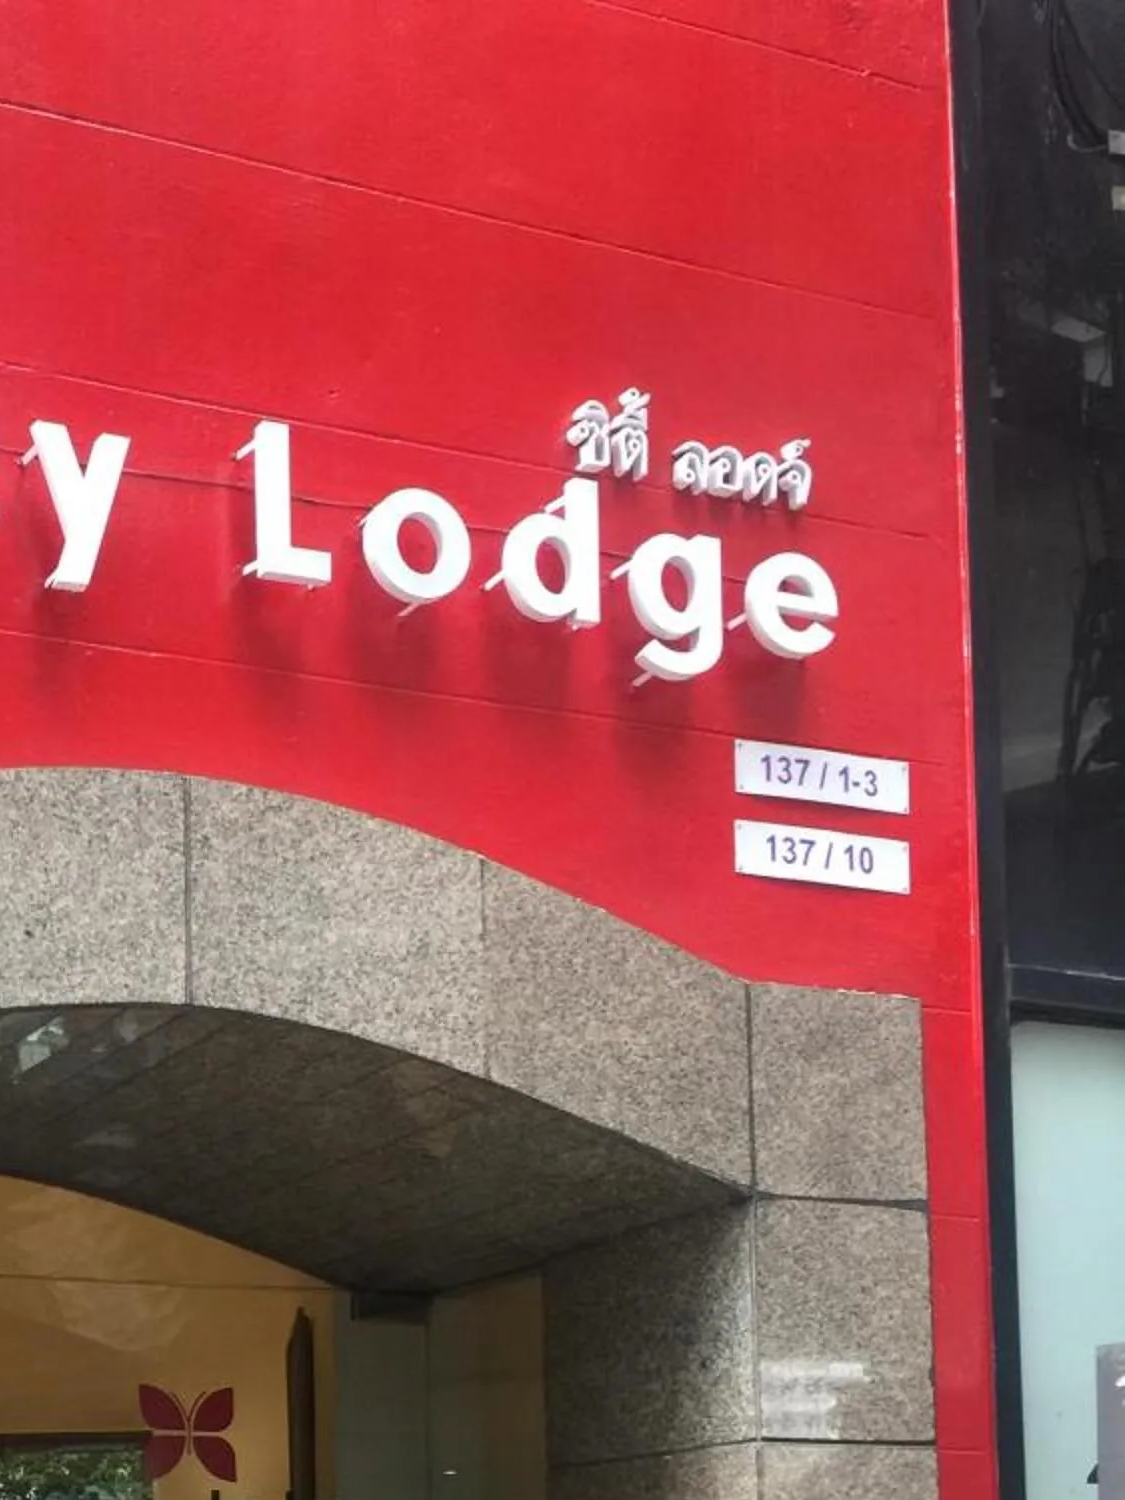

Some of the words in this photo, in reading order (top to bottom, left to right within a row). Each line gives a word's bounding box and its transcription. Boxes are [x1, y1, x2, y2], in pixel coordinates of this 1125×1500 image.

[565, 387, 652, 481] ซิตี้
[671, 438, 813, 511] ลอดจ์
[253, 420, 840, 681] Lodge
